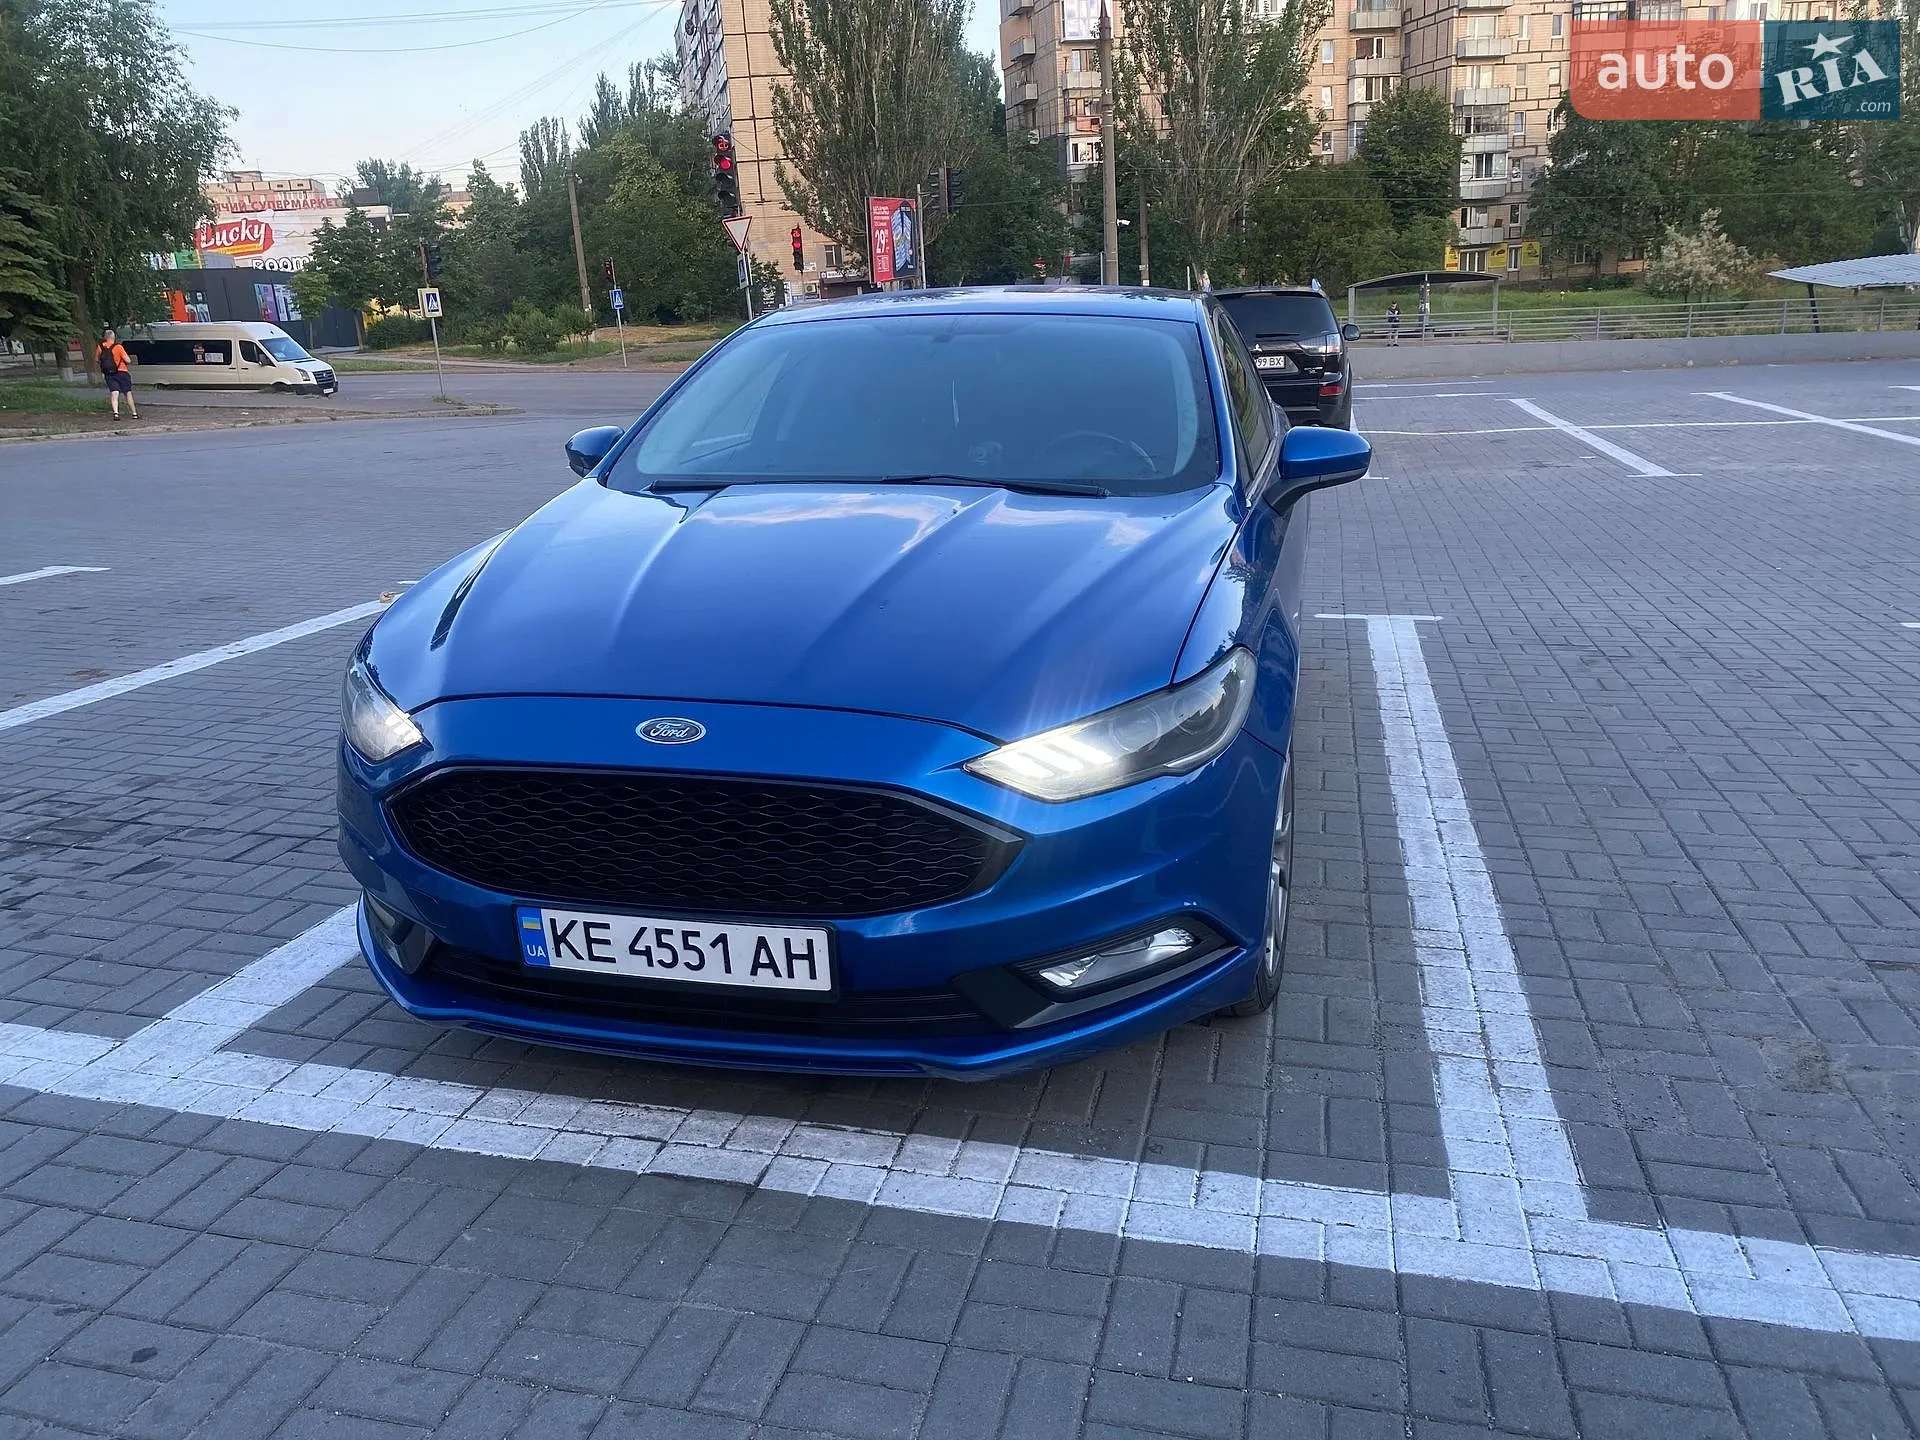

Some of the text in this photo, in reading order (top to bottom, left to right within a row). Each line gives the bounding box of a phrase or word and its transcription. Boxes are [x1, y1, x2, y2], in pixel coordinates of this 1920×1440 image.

[200, 217, 267, 249] Lucky
[650, 721, 690, 738] Ford
[526, 944, 546, 958] UA
[549, 917, 818, 980] KE 4551 AH
